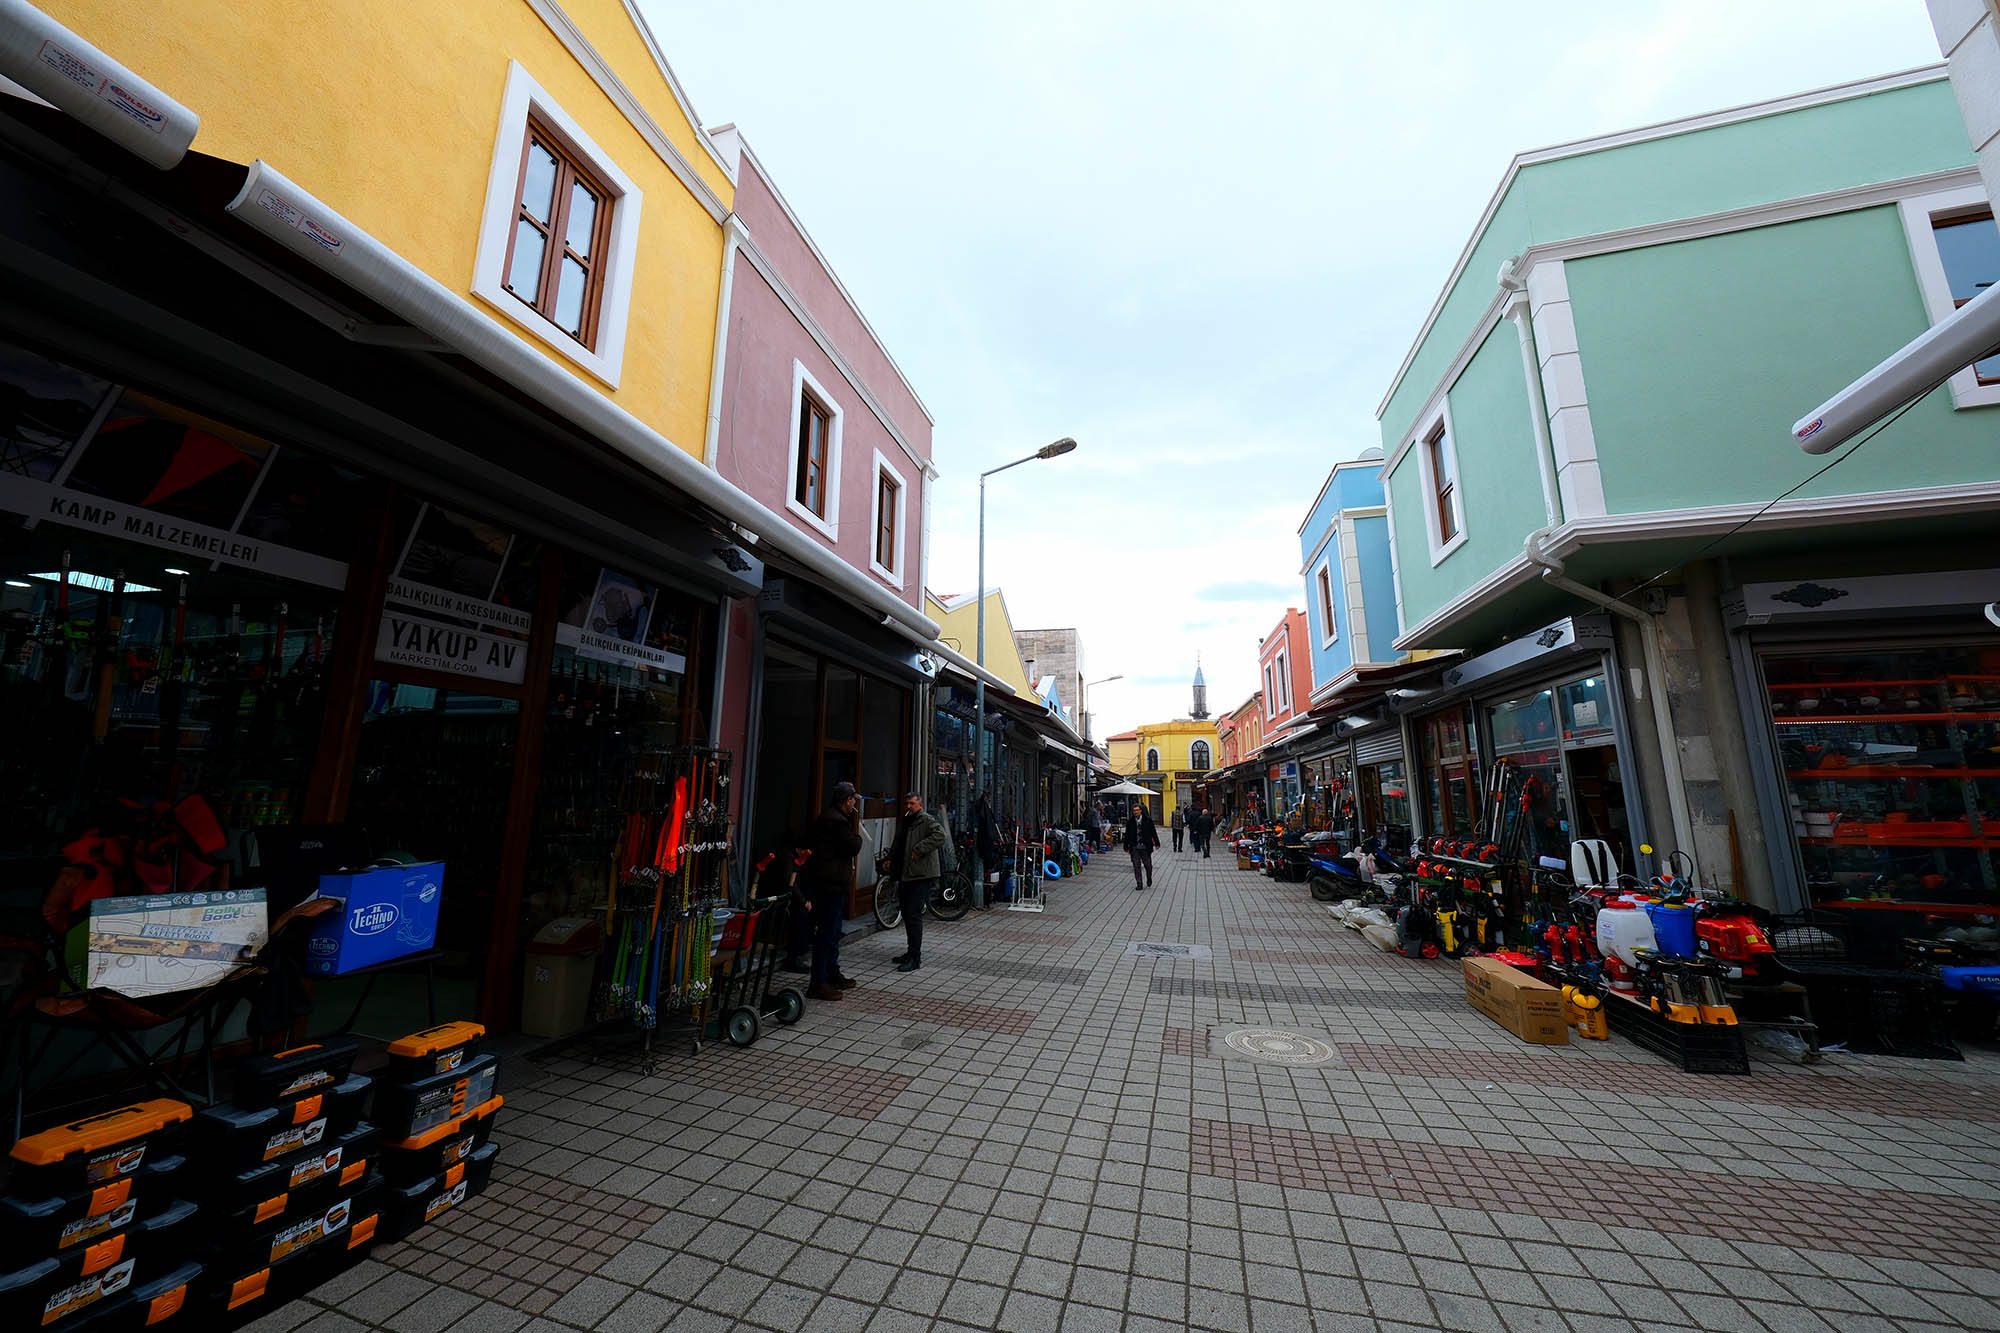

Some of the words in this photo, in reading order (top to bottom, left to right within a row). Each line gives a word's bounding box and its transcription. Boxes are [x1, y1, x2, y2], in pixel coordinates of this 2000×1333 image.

[50, 497, 115, 525] KAMP
[124, 516, 260, 563] MALZEMELERİ
[387, 583, 452, 609] BALIKÇILIK
[392, 619, 477, 660] YAKUP
[487, 642, 516, 668] AV
[580, 634, 620, 652] BALIKÇILIK
[202, 912, 240, 922] Boot
[353, 908, 394, 929] TECHNO
[148, 930, 181, 938] SAFETY
